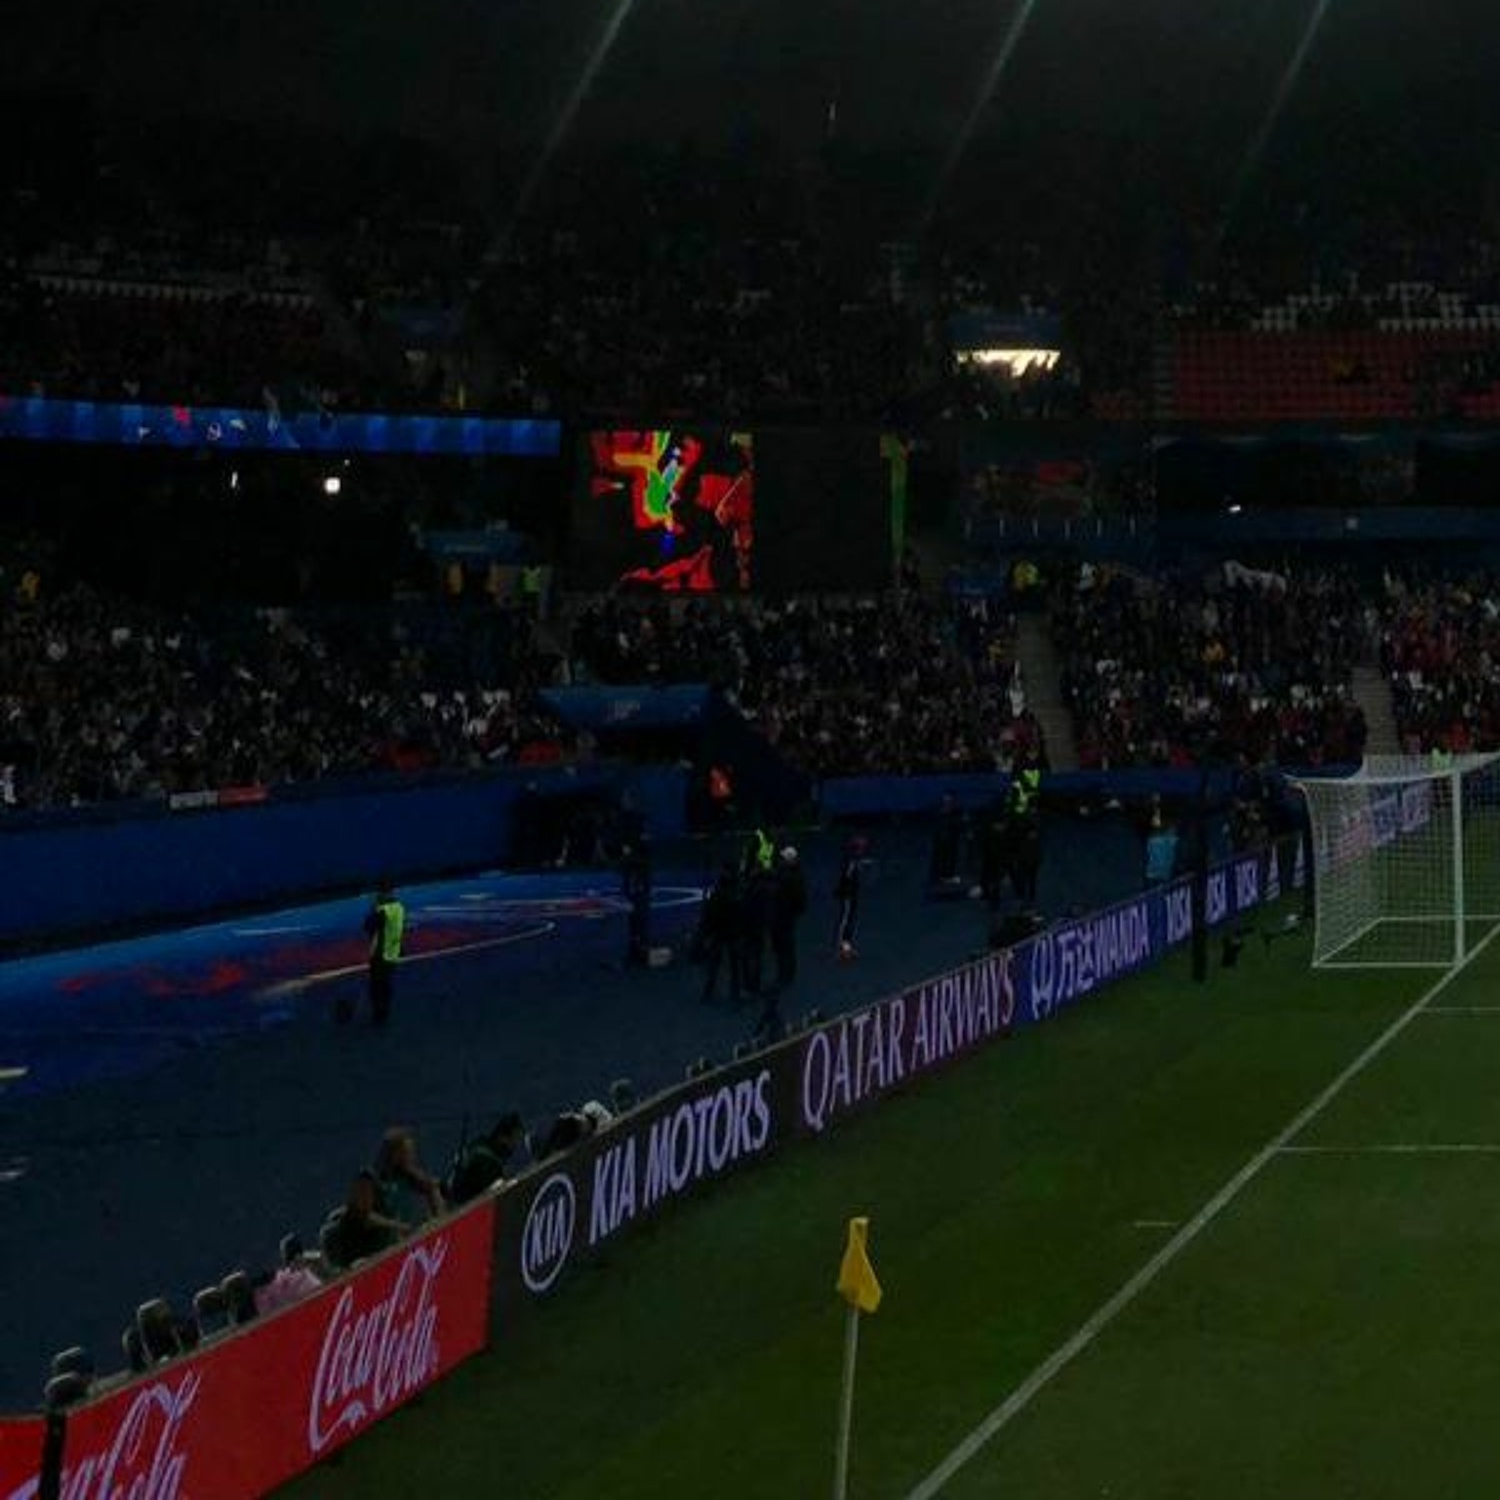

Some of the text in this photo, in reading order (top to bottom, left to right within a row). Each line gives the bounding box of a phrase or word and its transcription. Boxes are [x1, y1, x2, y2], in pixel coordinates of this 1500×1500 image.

[1093, 901, 1151, 979] WANDA
[803, 949, 1015, 1132] QATAR AIRWAYS
[530, 1068, 771, 1271] KIA KIA MOTORS
